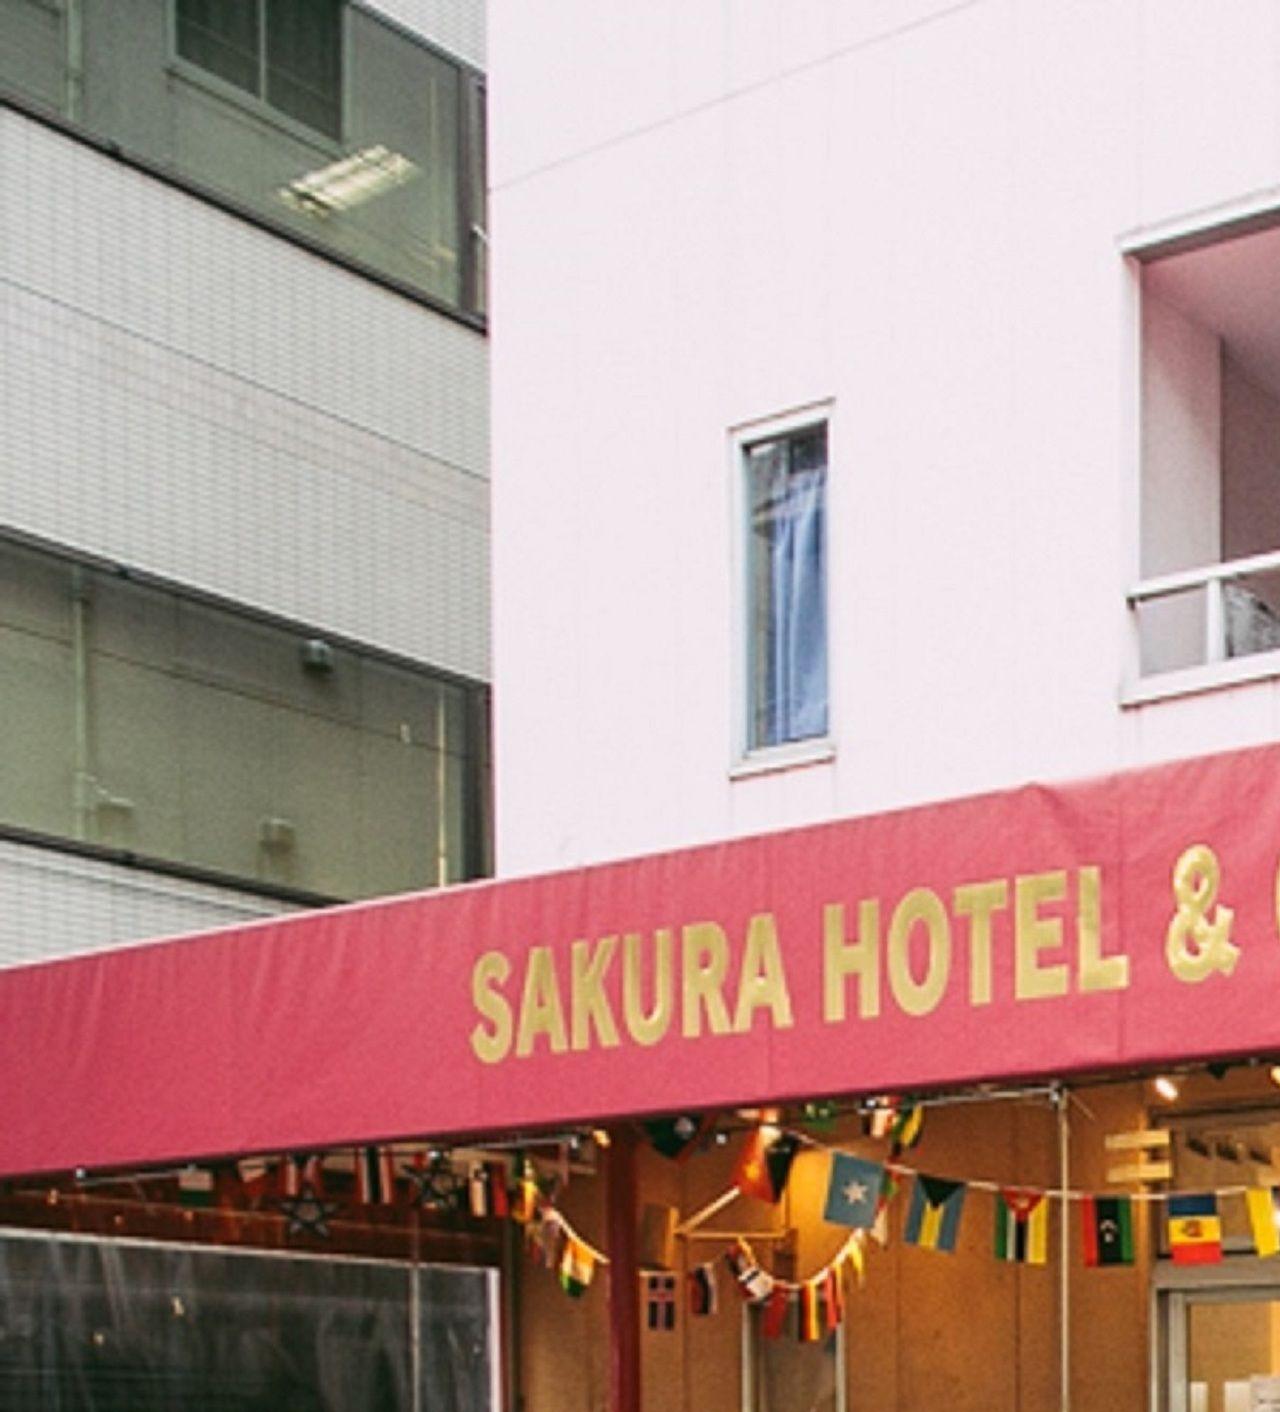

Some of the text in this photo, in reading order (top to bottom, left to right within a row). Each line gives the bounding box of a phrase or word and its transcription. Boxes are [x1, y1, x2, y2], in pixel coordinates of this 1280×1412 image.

[470, 910, 795, 1065] SAKURA
[822, 865, 1131, 1024] HOTEL
[1165, 842, 1242, 983] &
